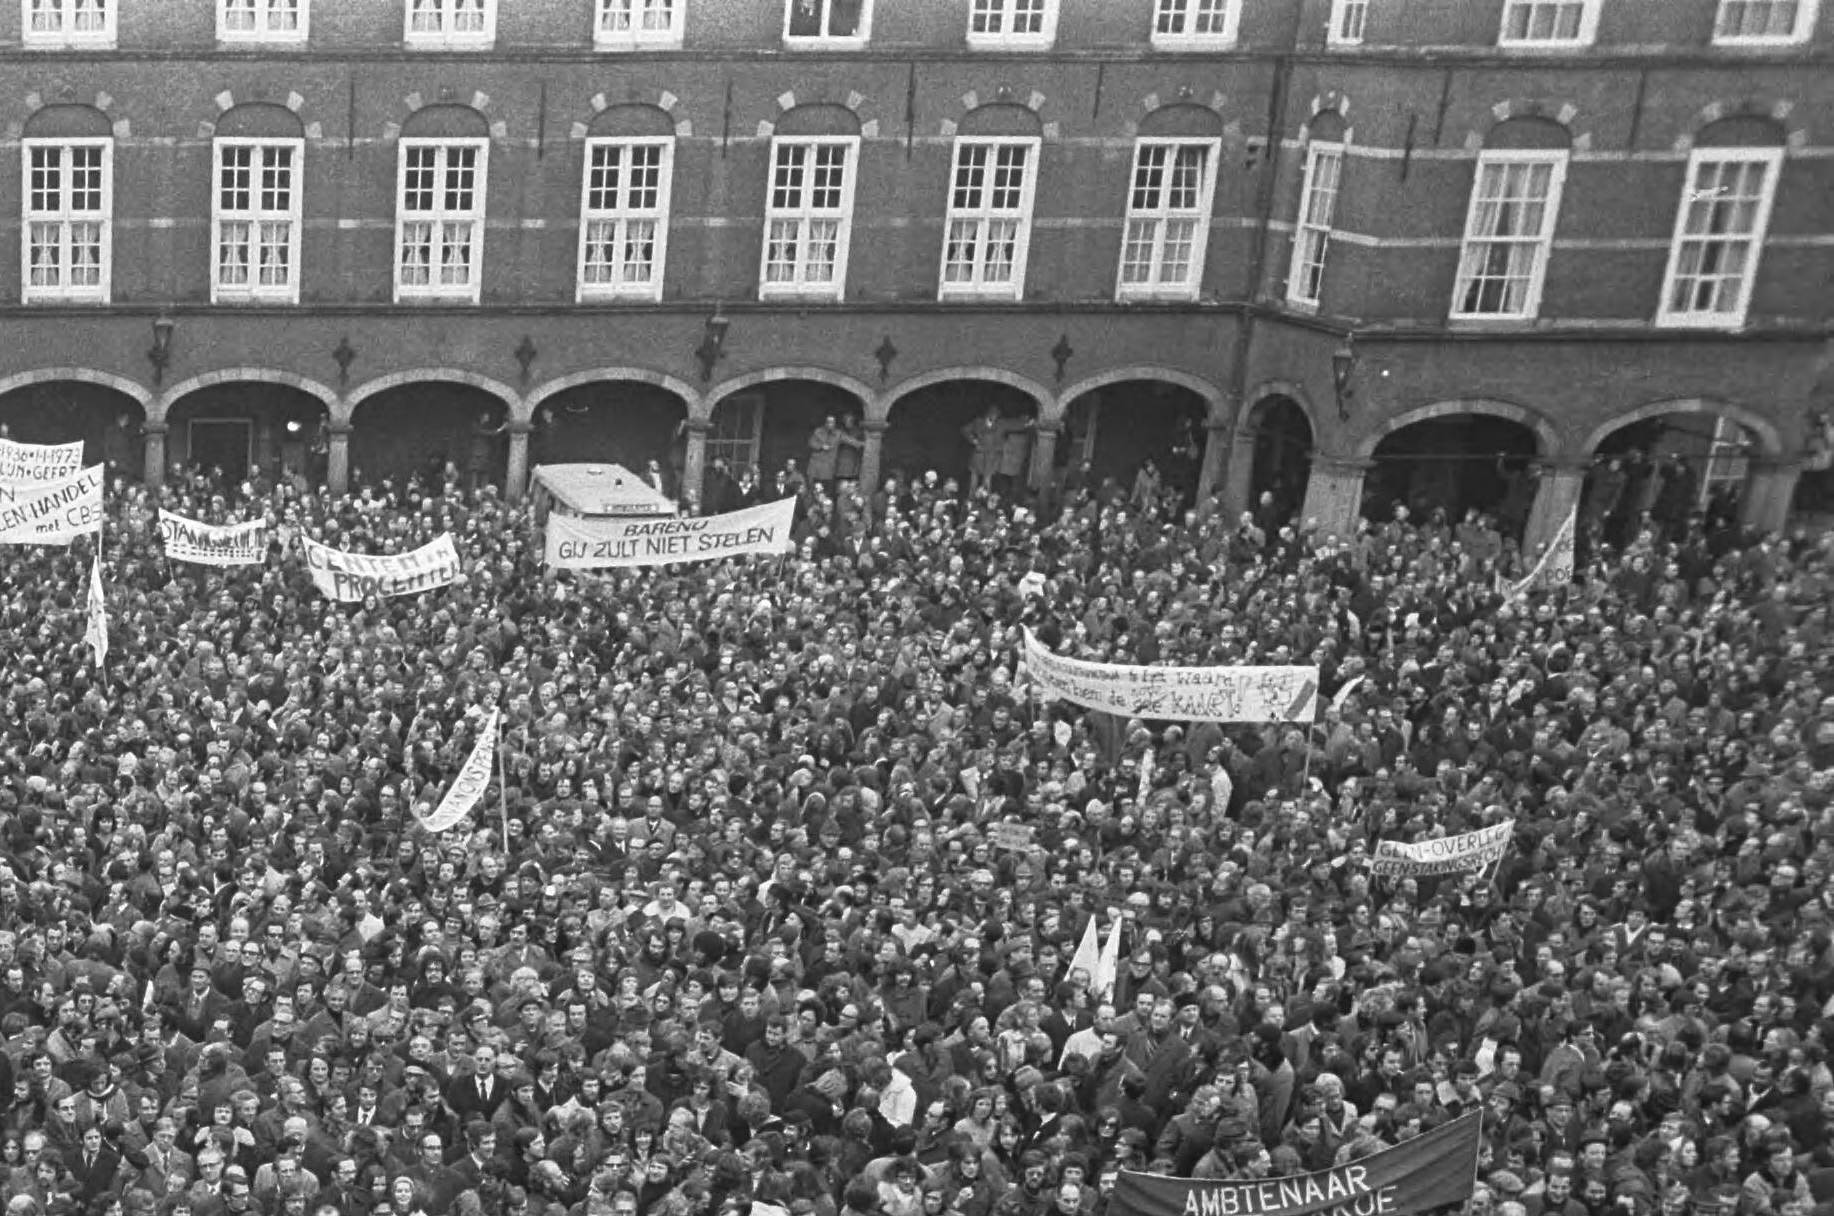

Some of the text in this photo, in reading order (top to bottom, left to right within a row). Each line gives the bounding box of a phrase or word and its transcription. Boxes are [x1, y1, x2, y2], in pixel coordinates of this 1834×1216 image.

[593, 538, 639, 558] ZULT
[646, 535, 693, 555] NIET
[698, 527, 775, 551] STELEN
